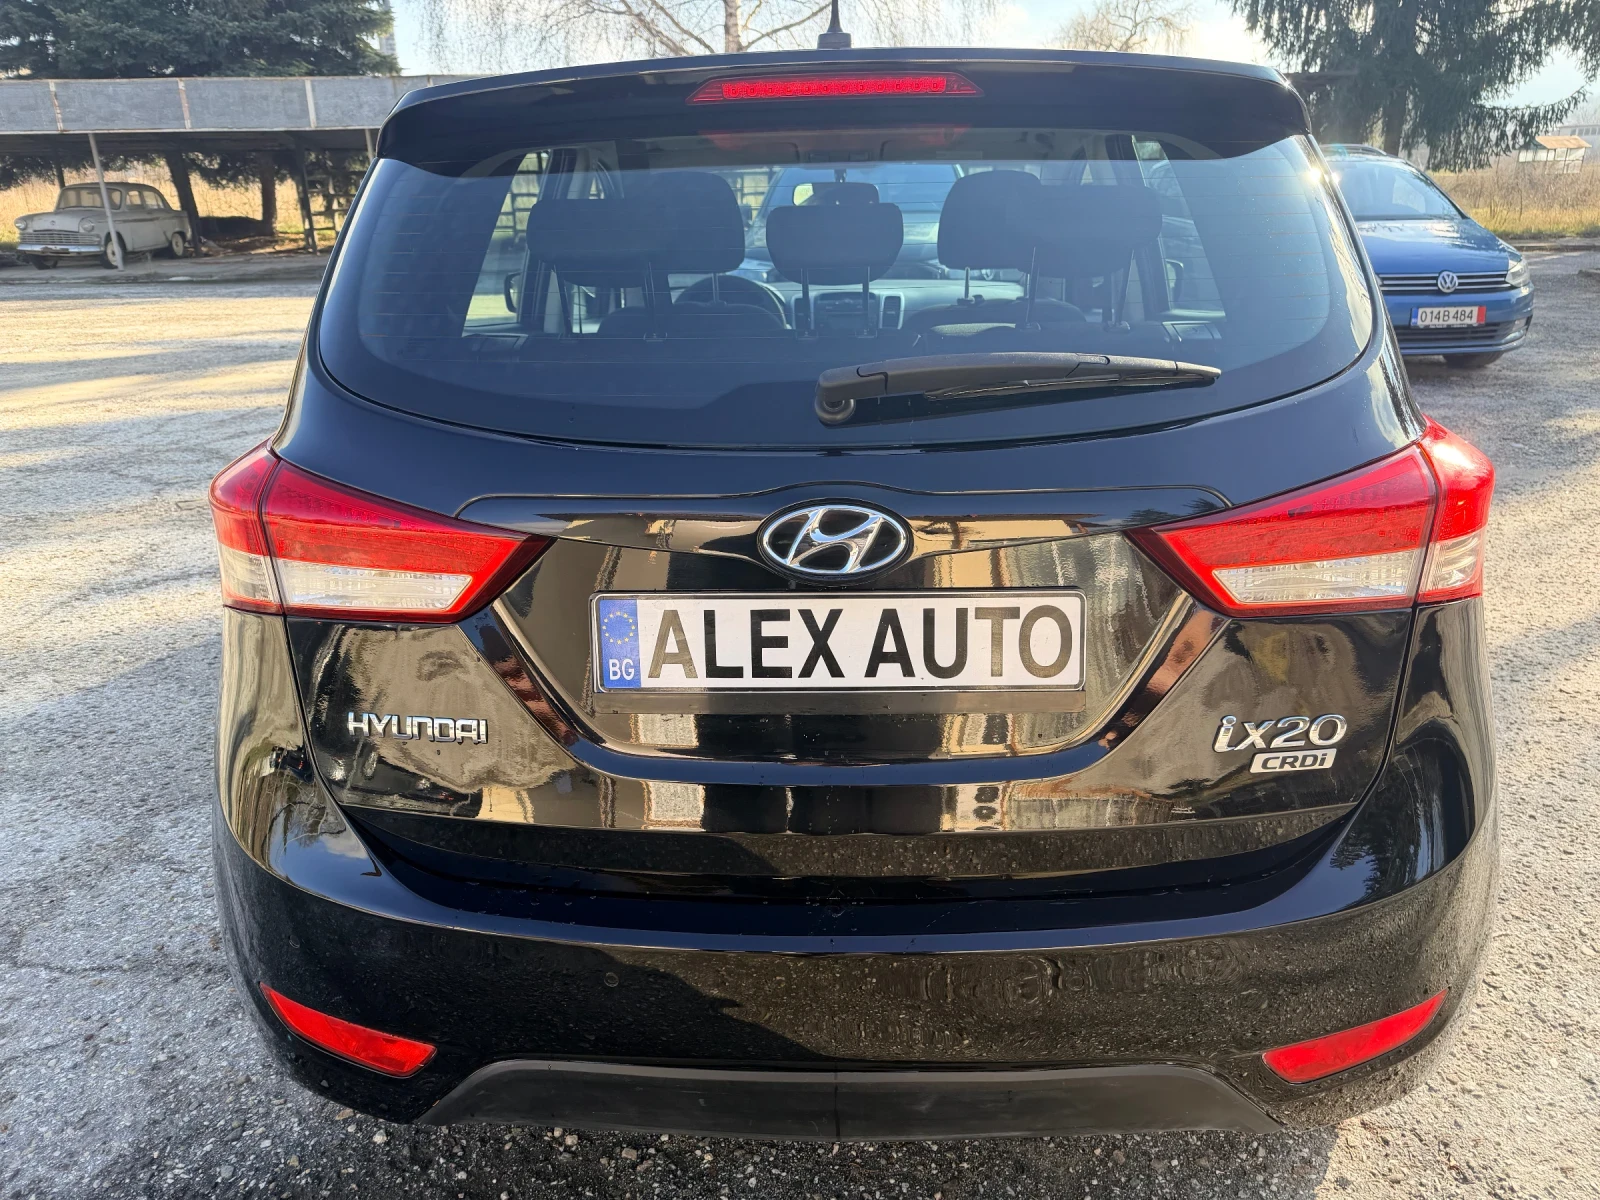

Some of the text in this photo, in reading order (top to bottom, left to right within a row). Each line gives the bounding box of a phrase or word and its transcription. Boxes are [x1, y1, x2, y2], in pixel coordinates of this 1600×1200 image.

[647, 604, 1073, 679] ALEX AUTO
[608, 658, 635, 680] BG
[347, 711, 488, 744] HYUNDAI
[1212, 714, 1348, 753] ix20
[1261, 752, 1328, 770] CRDi
